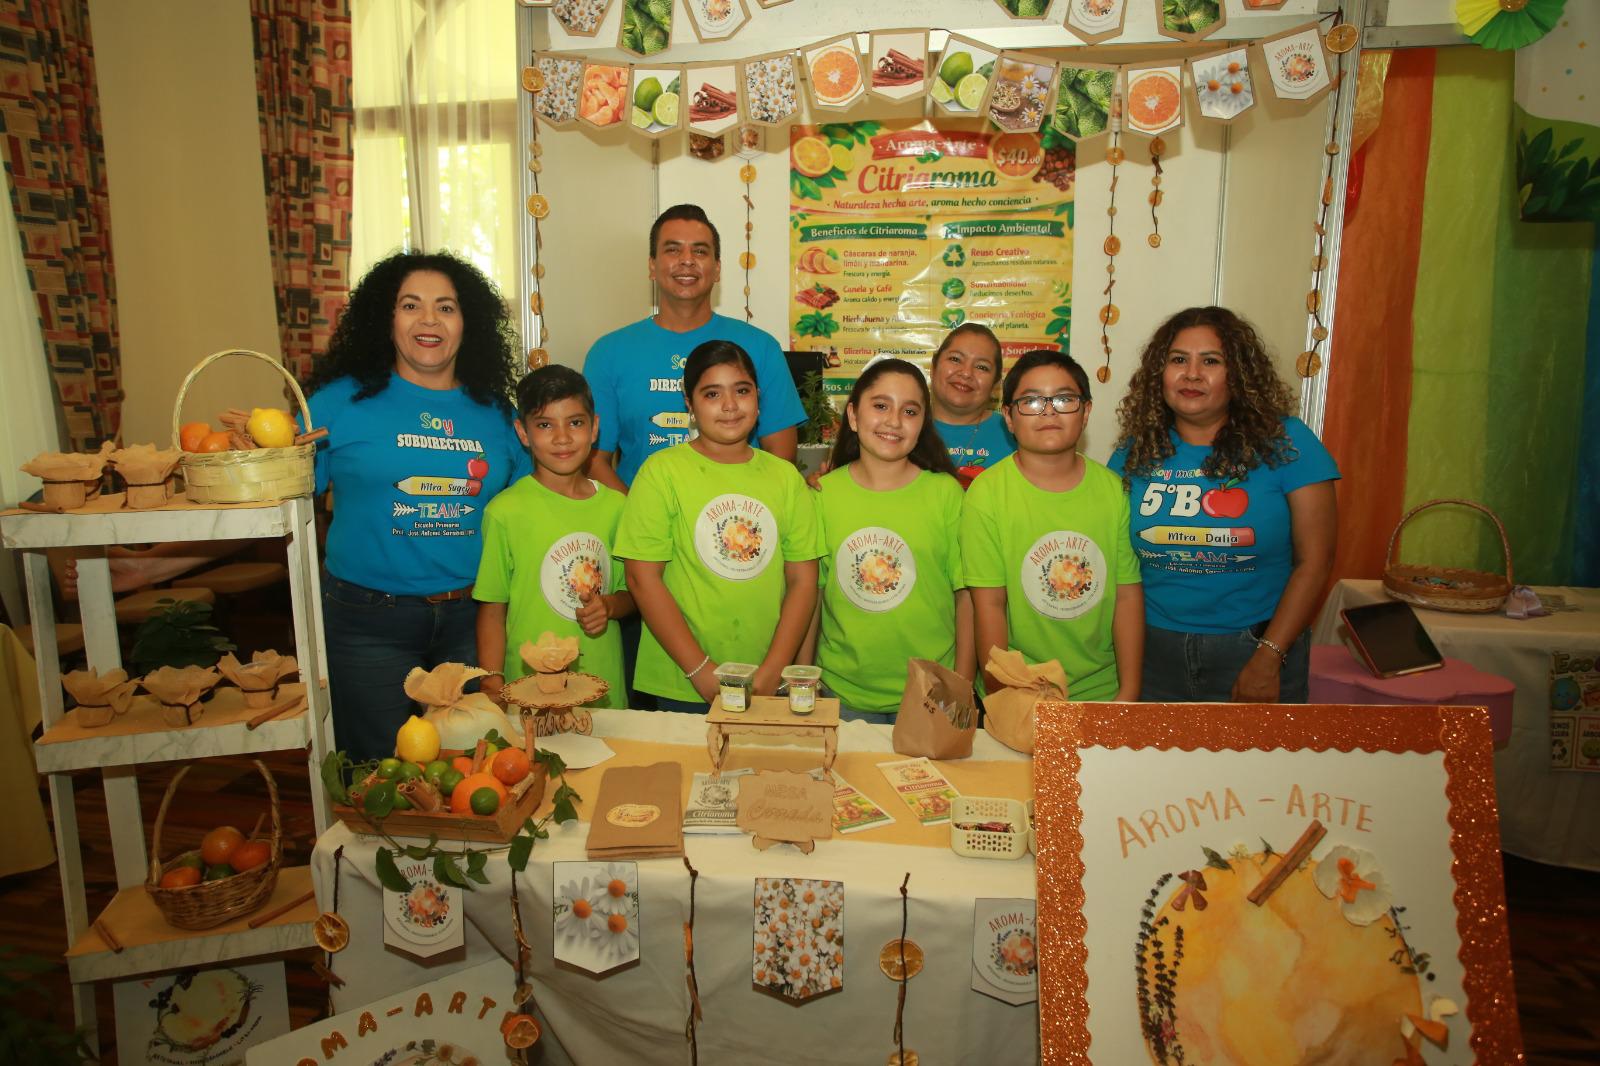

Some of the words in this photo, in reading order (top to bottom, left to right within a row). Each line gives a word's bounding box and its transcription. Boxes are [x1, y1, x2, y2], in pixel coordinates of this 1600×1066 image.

[996, 147, 1041, 166] $40.00
[857, 164, 999, 193] Citriaroma
[833, 199, 881, 210] Naturaleza
[881, 198, 907, 209] hecha
[961, 198, 988, 207] hecho
[988, 197, 1032, 207] conciencia
[811, 226, 857, 237] Beneficios
[858, 226, 869, 235] de
[869, 226, 918, 236] Citriaroma
[957, 224, 997, 235] Impacto
[998, 223, 1052, 233] Ambiental
[996, 247, 1030, 257] Creativo
[843, 285, 867, 293] Canela
[672, 354, 687, 369] So
[420, 412, 454, 436] Soy
[397, 433, 484, 452] SUBDIRECTORA
[418, 503, 461, 518] TEAM
[706, 499, 765, 522] AROMA-ARTE
[847, 533, 904, 554] AROMA-ARTE
[1205, 533, 1240, 543] Dalia
[550, 538, 604, 565] AROMA-ARTE
[1029, 536, 1090, 566] AROMA-ARTE
[1166, 550, 1229, 562] TEAM
[1116, 787, 1245, 858] AROMA
[1286, 783, 1374, 834] ARTE
